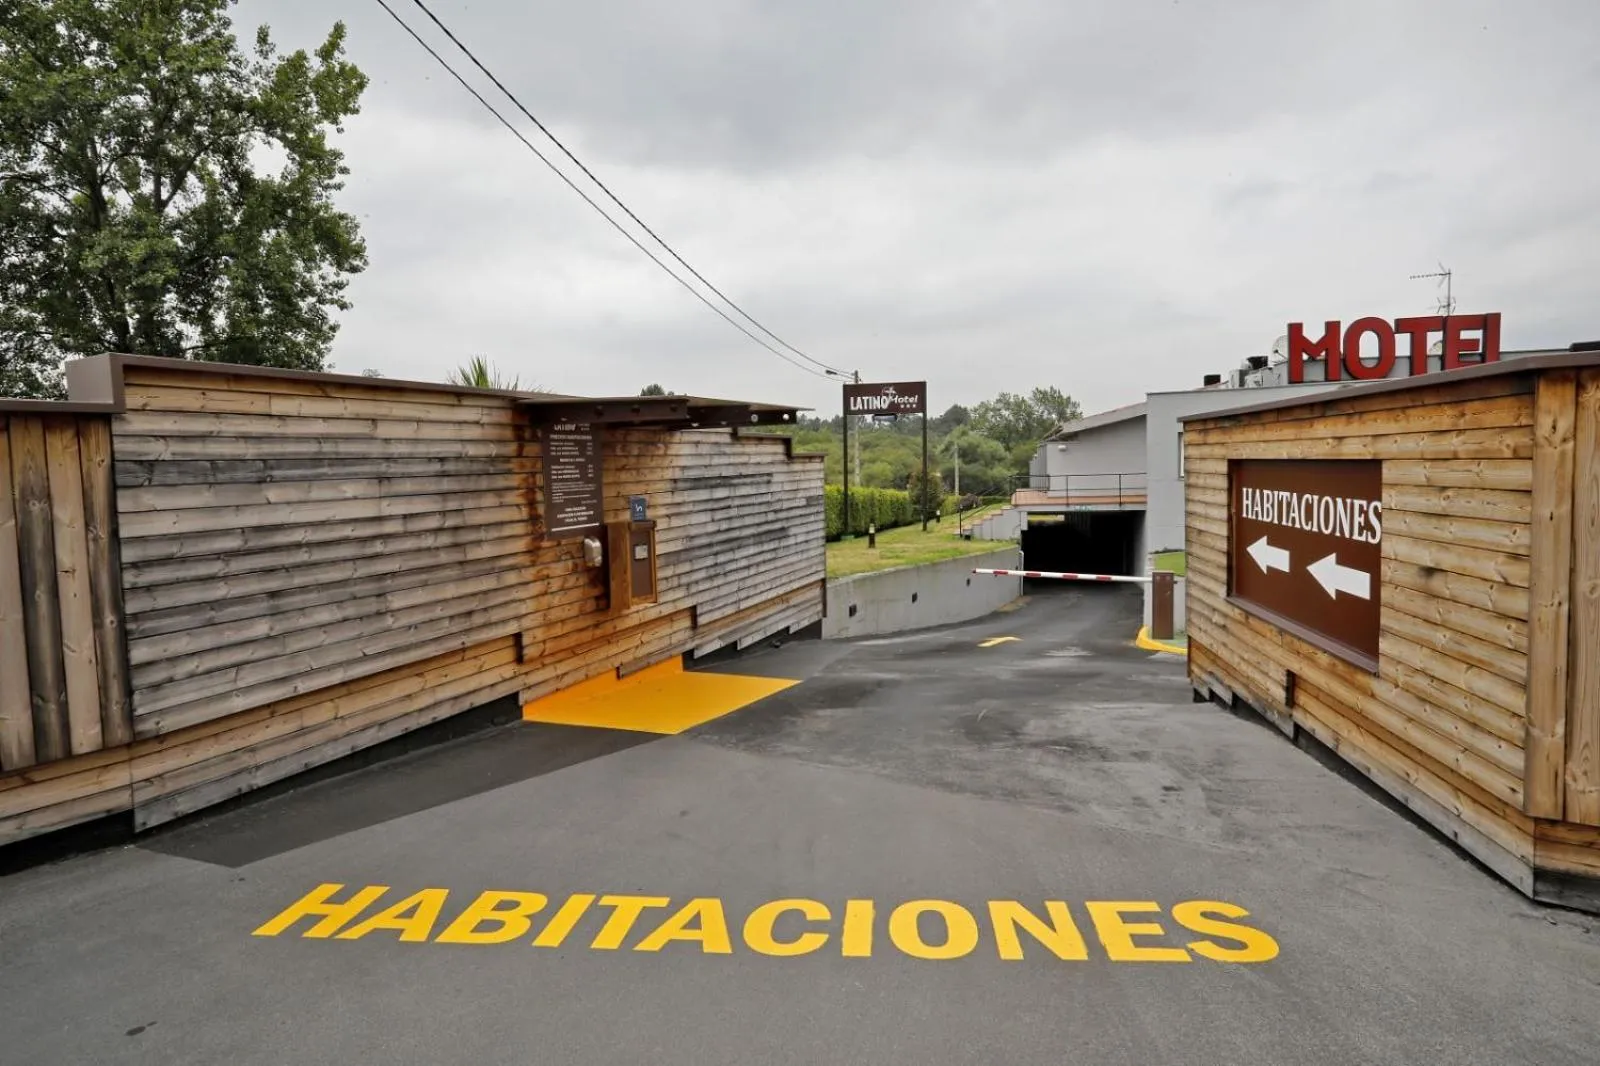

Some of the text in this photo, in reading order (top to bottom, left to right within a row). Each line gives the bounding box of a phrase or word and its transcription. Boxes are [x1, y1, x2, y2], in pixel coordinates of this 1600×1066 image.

[850, 395, 918, 410] LATINO Hotel
[1242, 487, 1382, 545] HABITACIONES
[251, 883, 1281, 963] HABITACIONES
